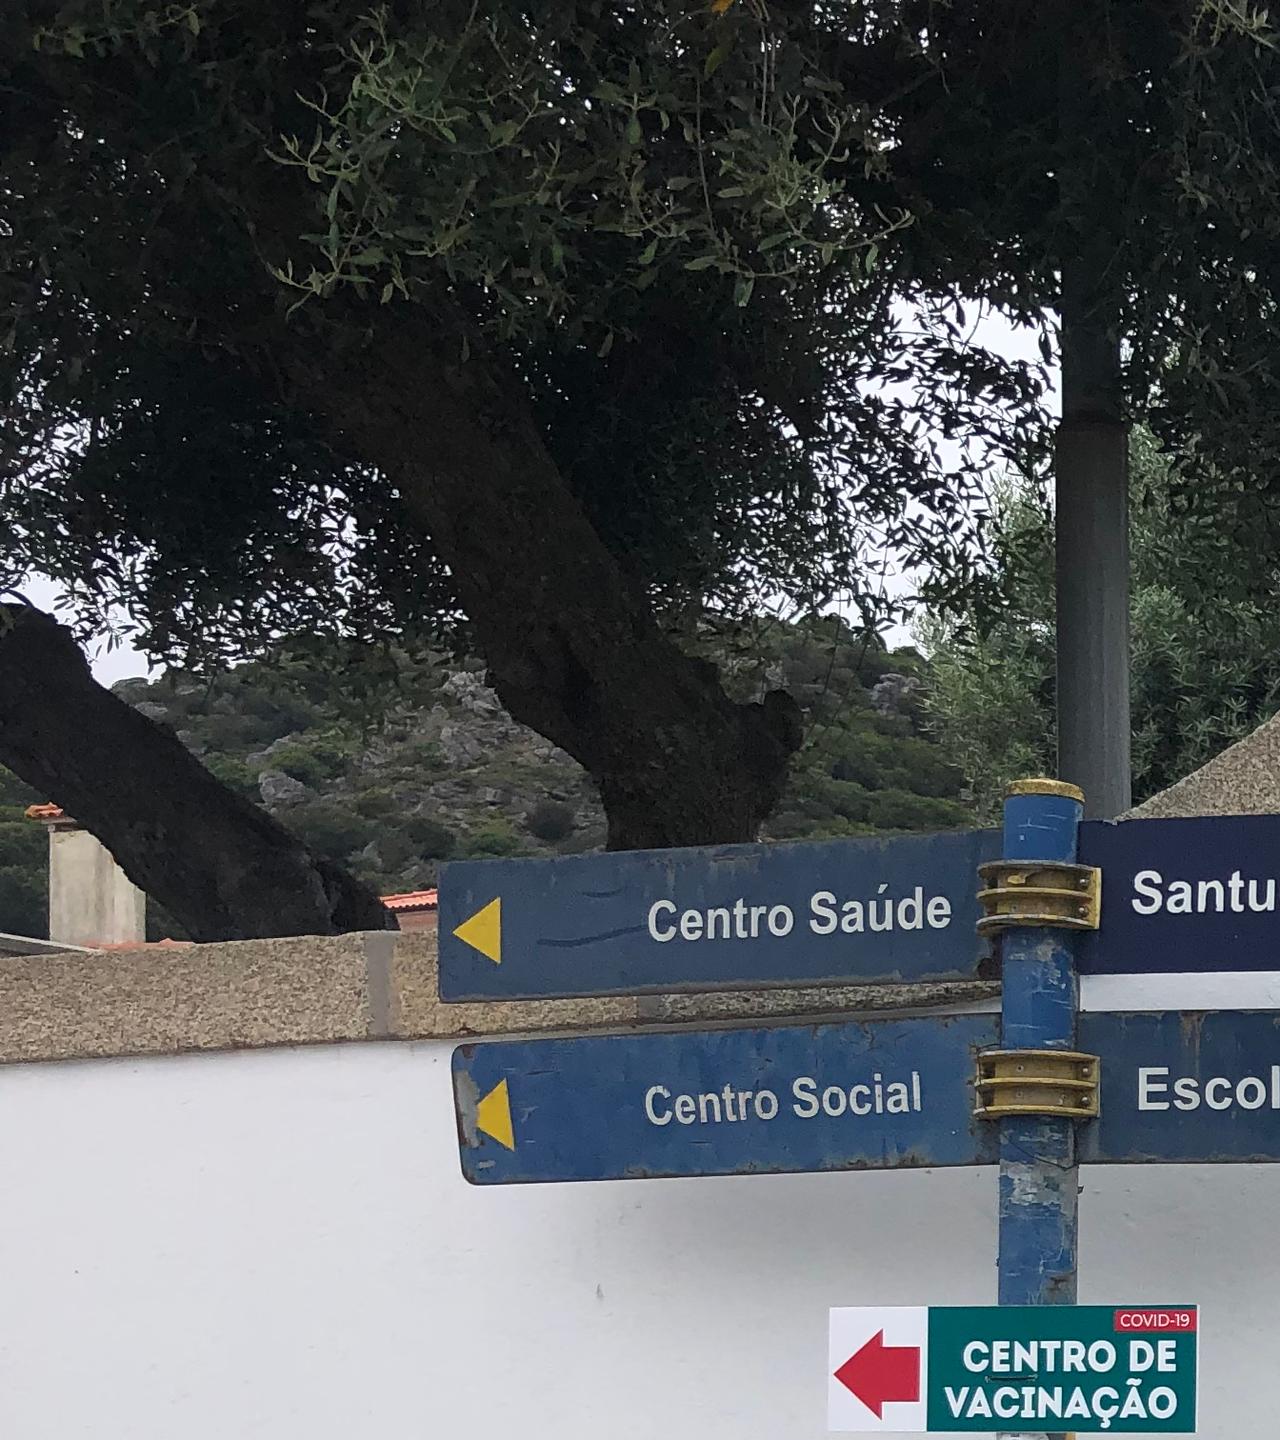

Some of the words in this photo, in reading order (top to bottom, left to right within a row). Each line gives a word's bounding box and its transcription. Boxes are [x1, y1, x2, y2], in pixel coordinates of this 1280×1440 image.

[648, 897, 795, 943] Centro
[809, 883, 952, 935] Saúde
[644, 1082, 779, 1126] Centro
[792, 1070, 922, 1119] Social
[1119, 1312, 1191, 1329] COVID-19
[962, 1340, 1117, 1373] CENTRO
[1129, 1340, 1178, 1372] DE
[944, 1377, 1178, 1429] VACINAÇÃO
